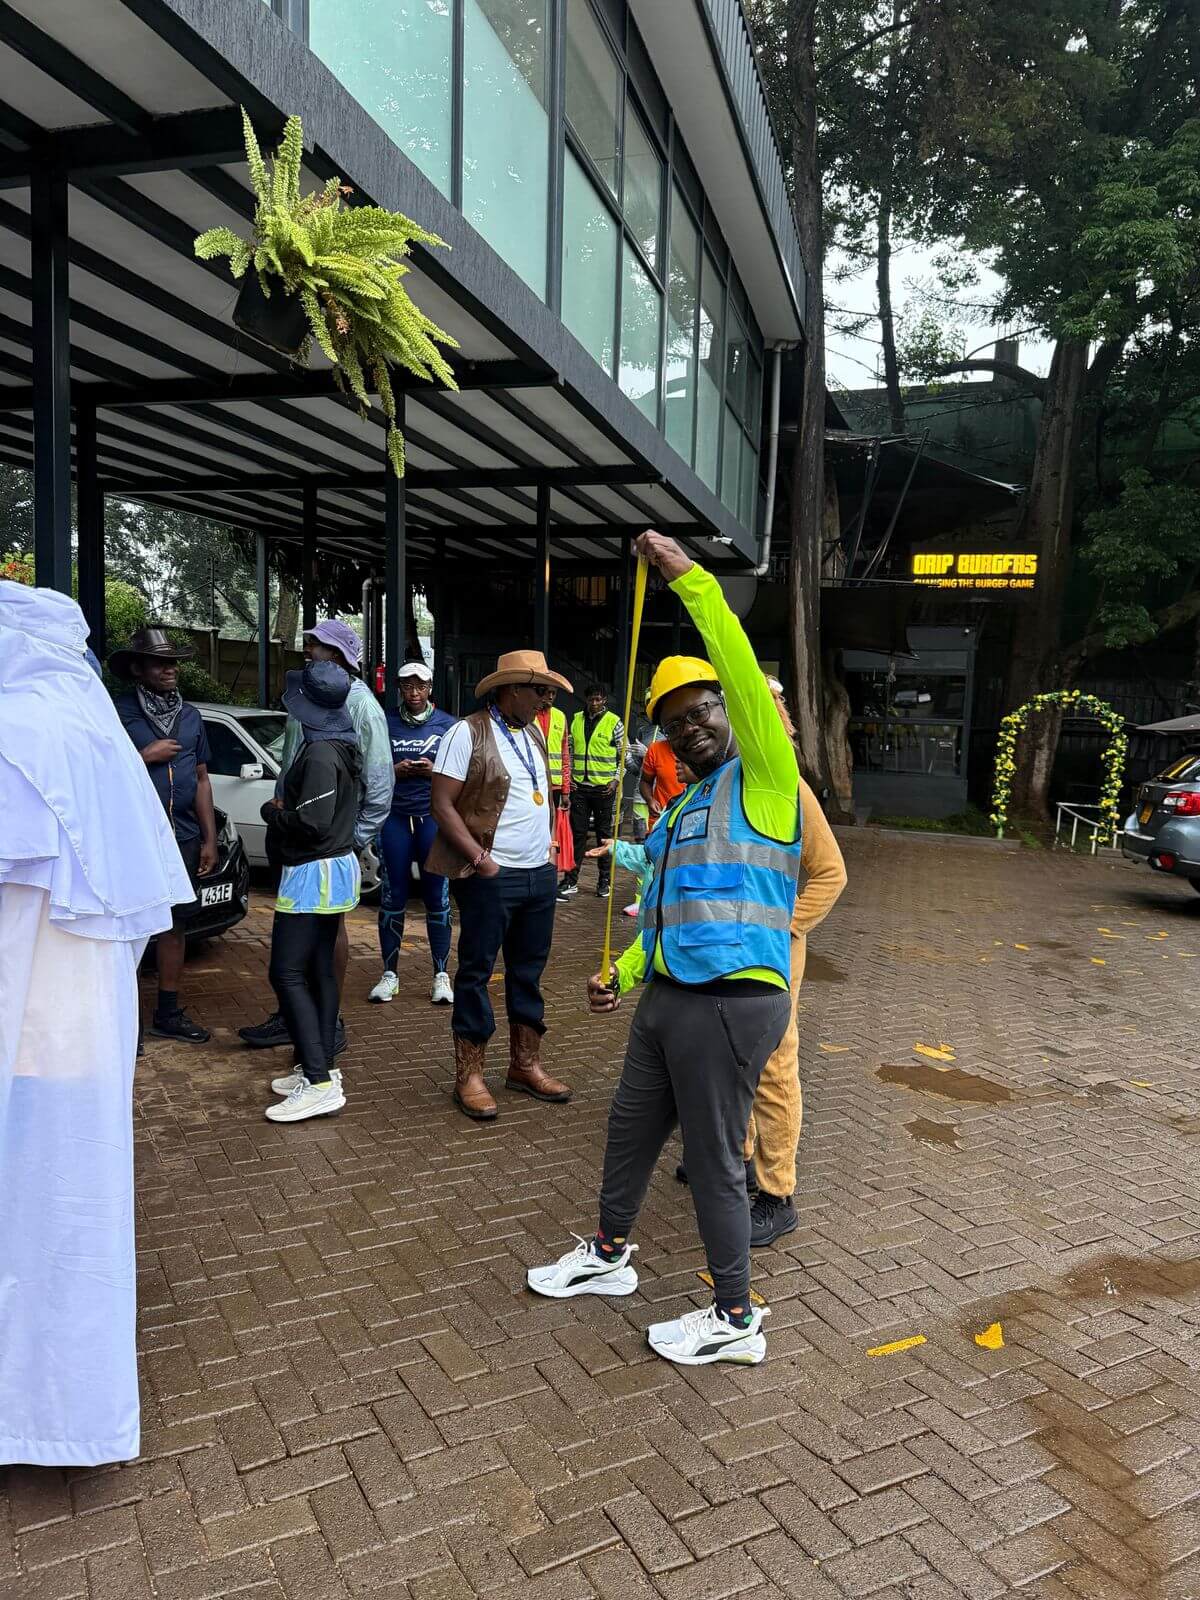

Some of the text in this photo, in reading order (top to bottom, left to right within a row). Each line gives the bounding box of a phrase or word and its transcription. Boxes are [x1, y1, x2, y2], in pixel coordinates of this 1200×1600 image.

[957, 554, 1038, 574] BURGERS
[958, 579, 974, 588] THE
[975, 579, 1008, 588] BURGER
[1009, 579, 1035, 588] GAME
[205, 884, 231, 904] 431E
